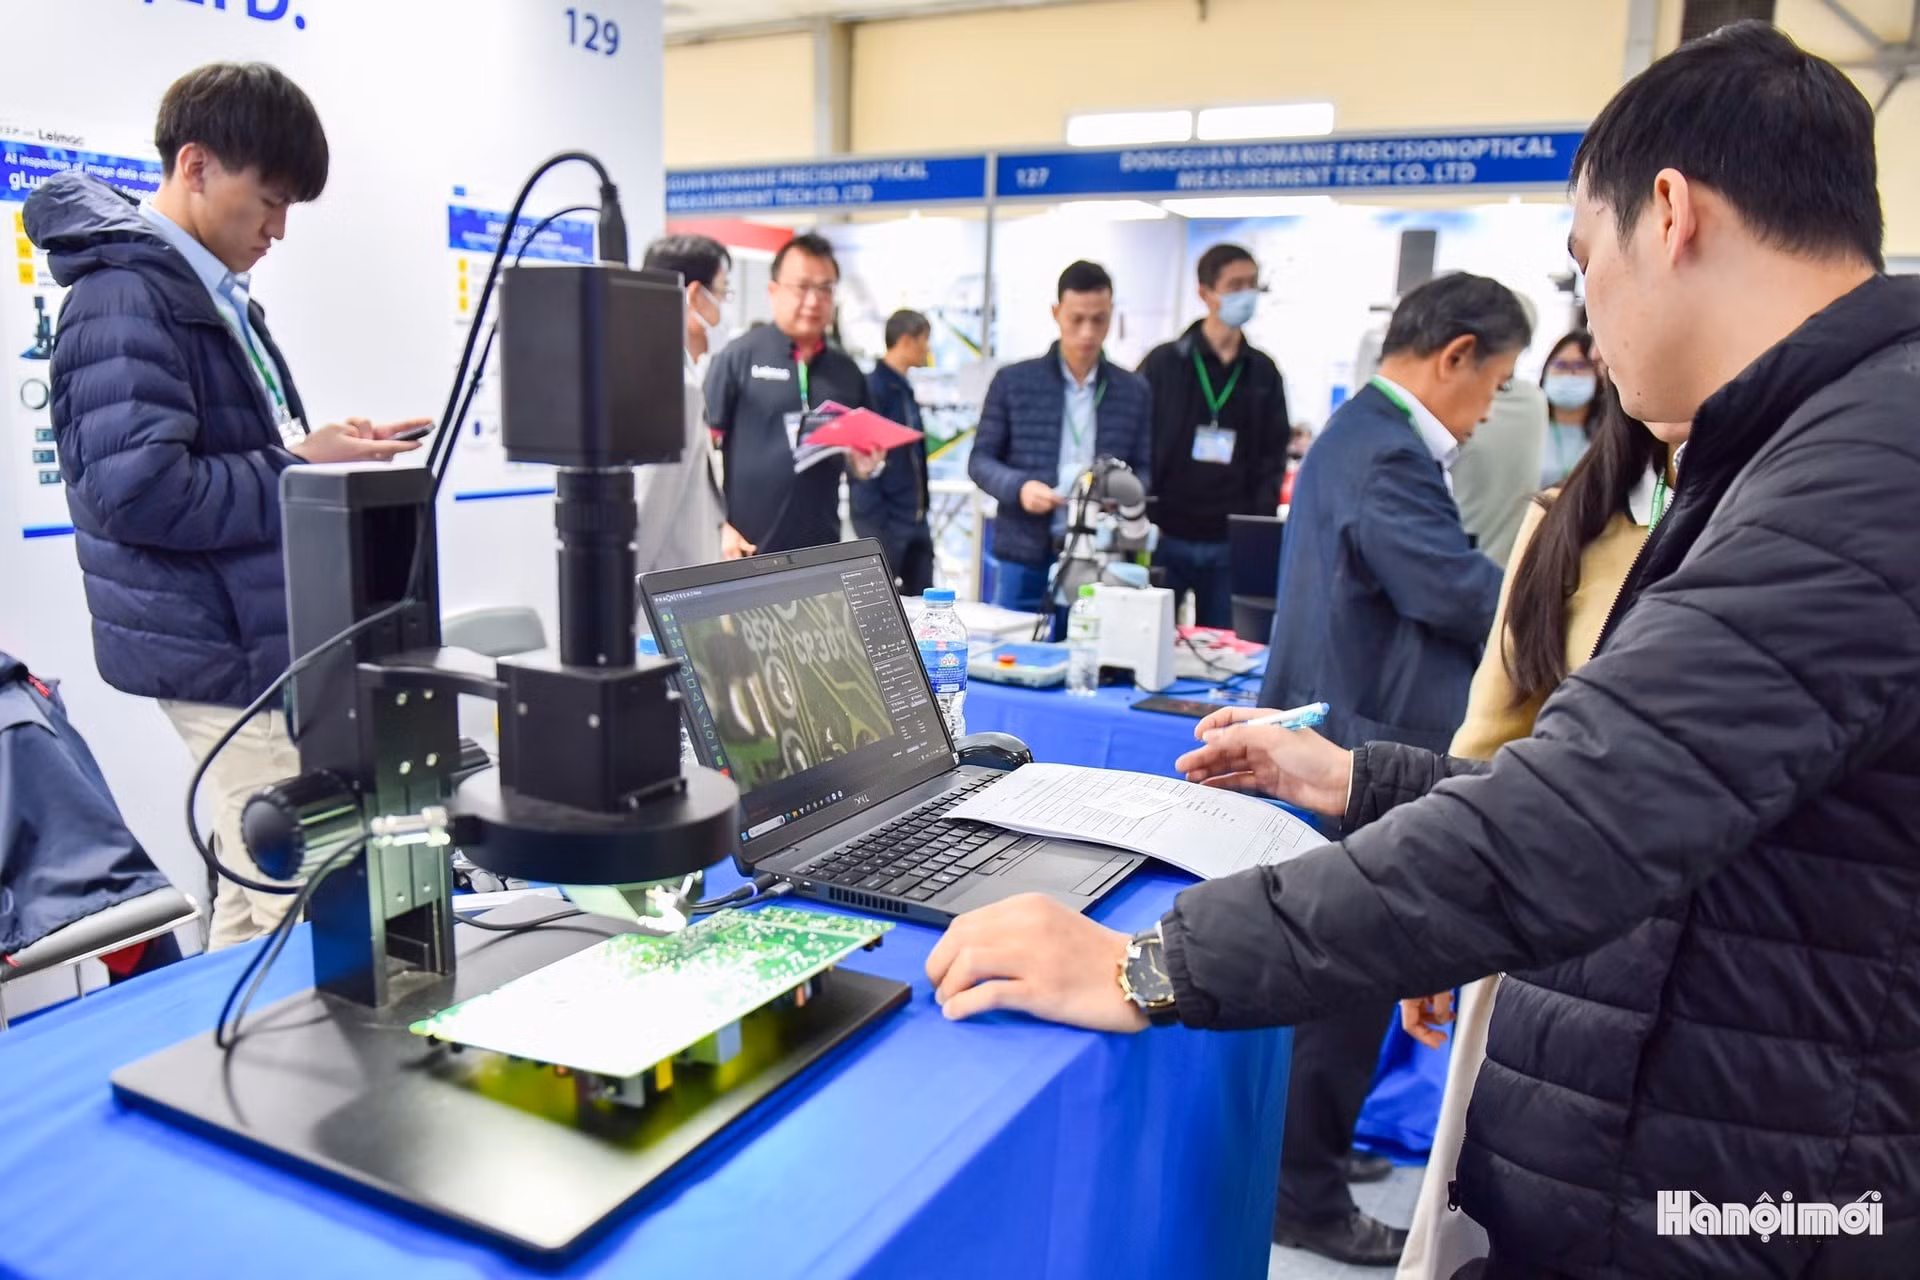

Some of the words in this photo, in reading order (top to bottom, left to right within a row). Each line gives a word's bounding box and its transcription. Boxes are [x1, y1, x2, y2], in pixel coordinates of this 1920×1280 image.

[565, 8, 619, 55] 129
[1119, 146, 1235, 171] DONGGUAN
[1015, 167, 1050, 189] 127
[1176, 165, 1332, 190] MEASUREMENT
